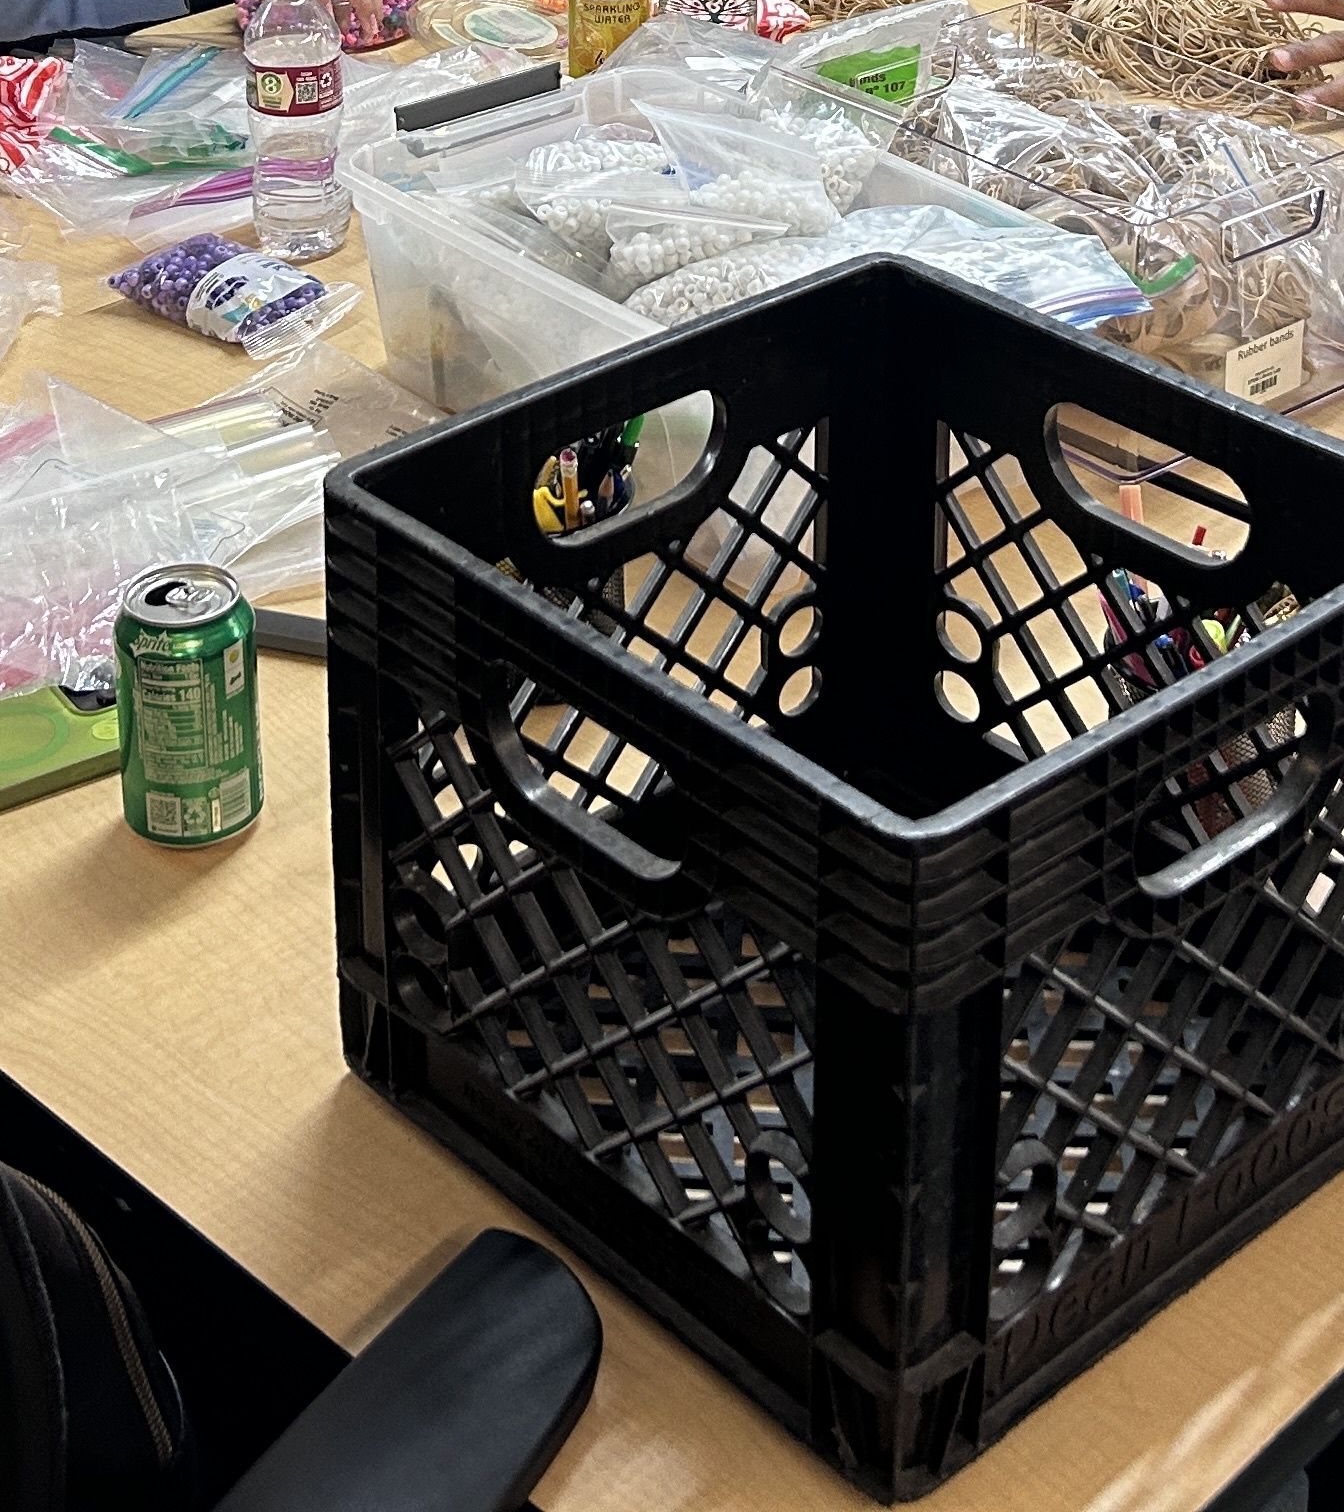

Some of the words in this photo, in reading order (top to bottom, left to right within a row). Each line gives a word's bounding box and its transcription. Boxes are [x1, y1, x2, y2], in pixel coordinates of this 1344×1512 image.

[583, 2, 641, 13] SPARKLING
[594, 15, 631, 25] WATER
[884, 81, 906, 93] 107
[1237, 340, 1267, 361] Rubber
[1270, 329, 1294, 347] bands
[134, 635, 171, 654] Sprite
